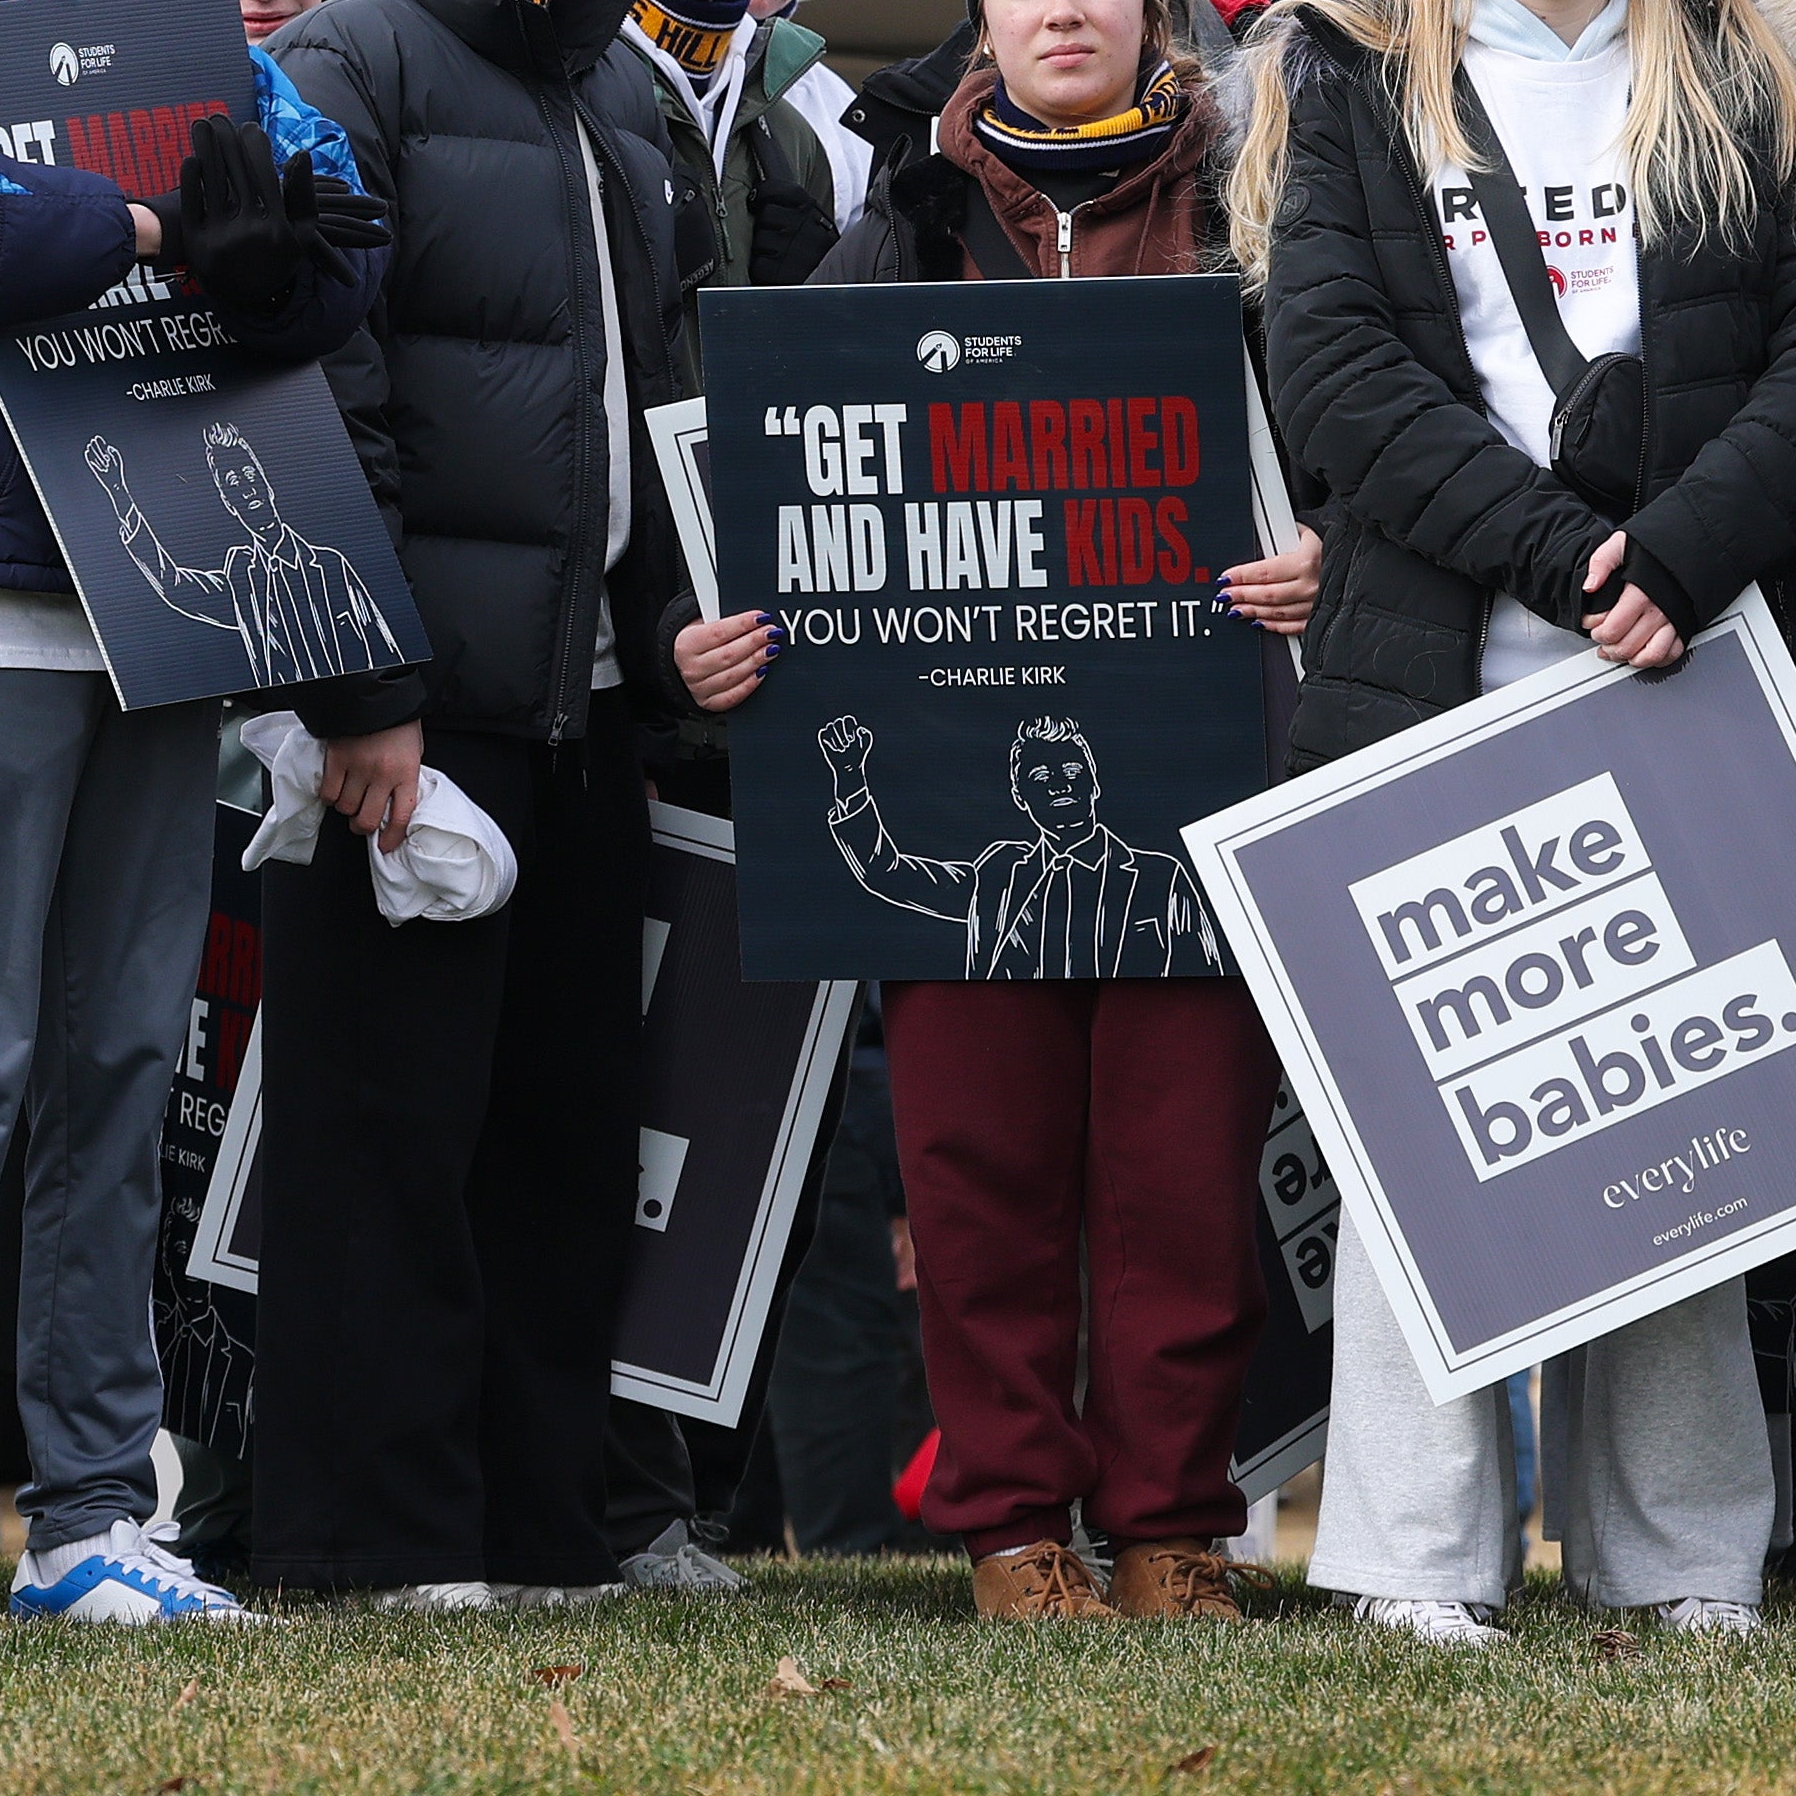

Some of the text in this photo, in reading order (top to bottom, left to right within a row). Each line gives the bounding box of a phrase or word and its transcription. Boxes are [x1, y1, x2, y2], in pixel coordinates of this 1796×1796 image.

[78, 44, 116, 59] STUDENTS
[81, 59, 97, 69] FOR
[656, 17, 724, 68] HILL
[65, 99, 229, 201] MARRI
[1471, 226, 1617, 250] PBORN
[1570, 266, 1614, 279] STUDENTS
[16, 310, 238, 373] YOU WON’T REGR
[964, 336, 1022, 348] STUDENTS
[965, 348, 989, 358] FOR
[126, 372, 217, 402] -CHARLIE KIRK
[764, 395, 1203, 497] “GET MARRIED
[777, 496, 1210, 593] AND HAVE KIDS.
[779, 607, 863, 646] YOU
[871, 605, 1003, 645] WON’T
[1014, 601, 1159, 643] REGRET
[918, 665, 1067, 688] -CHARLIE KIRK
[1375, 817, 1627, 966] make
[1415, 907, 1662, 1052] more
[177, 1146, 206, 1173] KIRK
[1602, 1124, 1752, 1209] everylife
[1652, 1195, 1749, 1247] everylife.com
